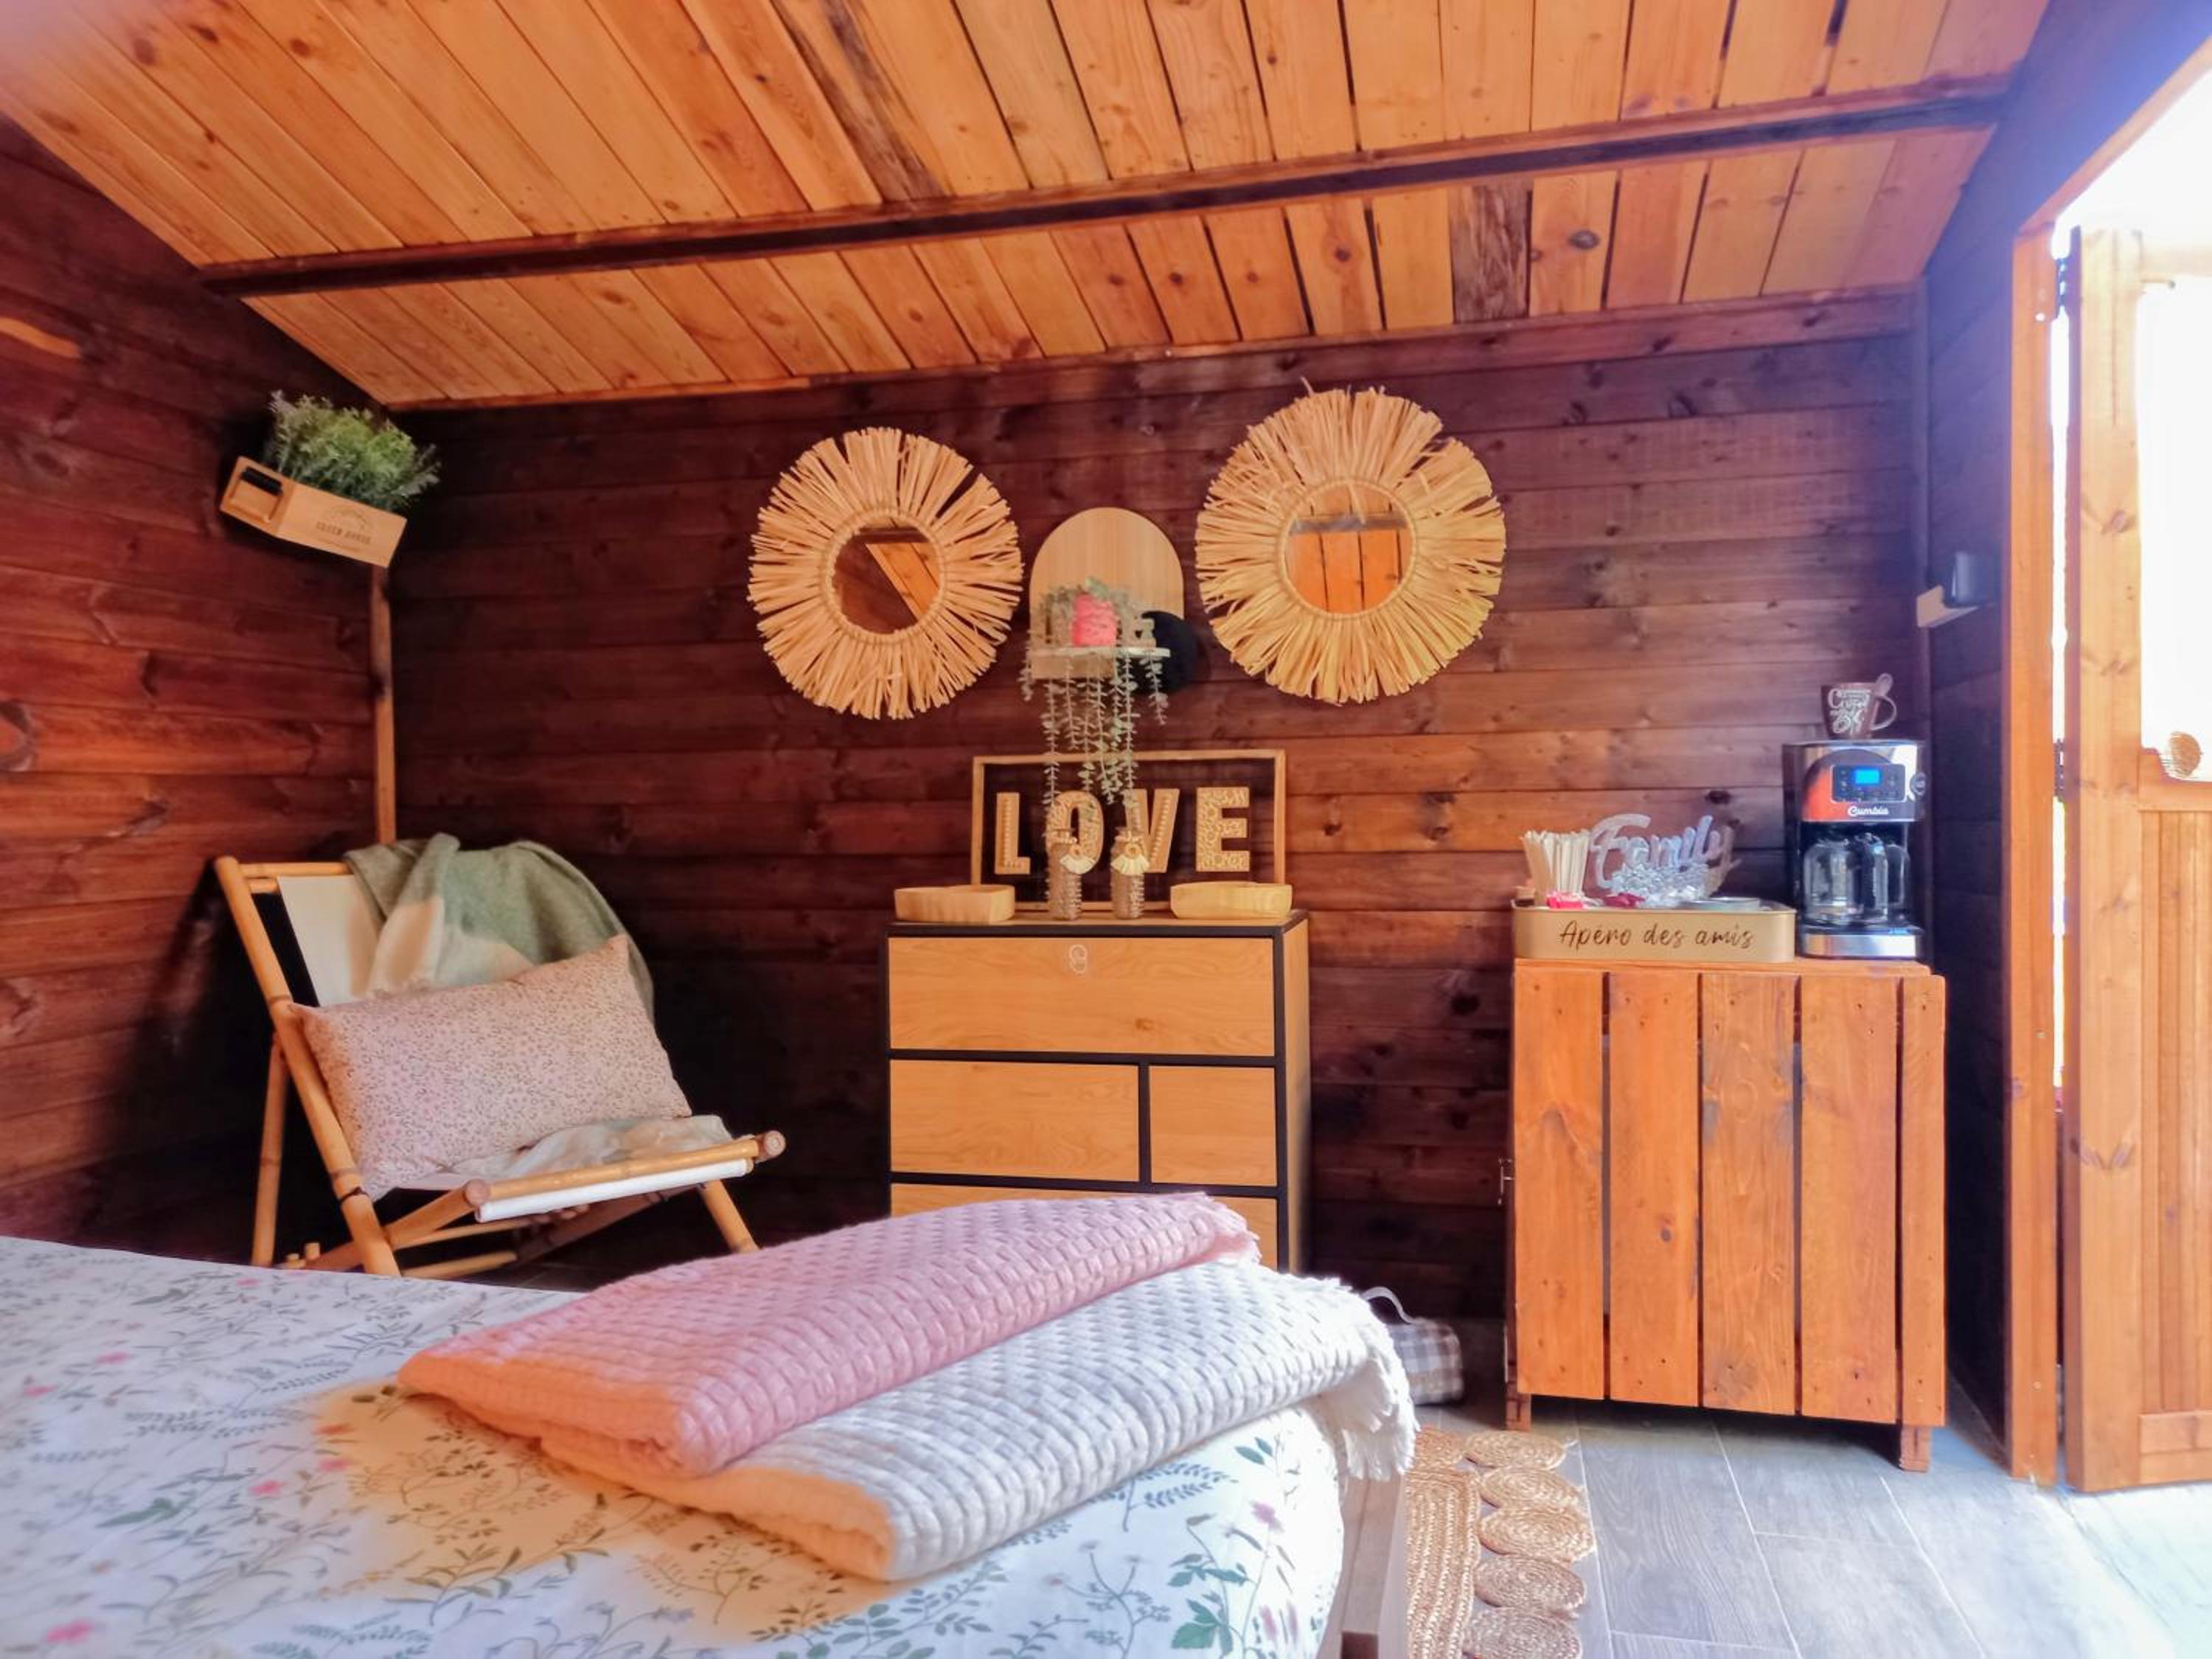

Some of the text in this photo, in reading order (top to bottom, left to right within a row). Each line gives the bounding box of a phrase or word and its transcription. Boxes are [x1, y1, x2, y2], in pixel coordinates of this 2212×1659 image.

[995, 786, 1251, 875] LOVE
[1559, 919, 1756, 950] Apéro des amis
